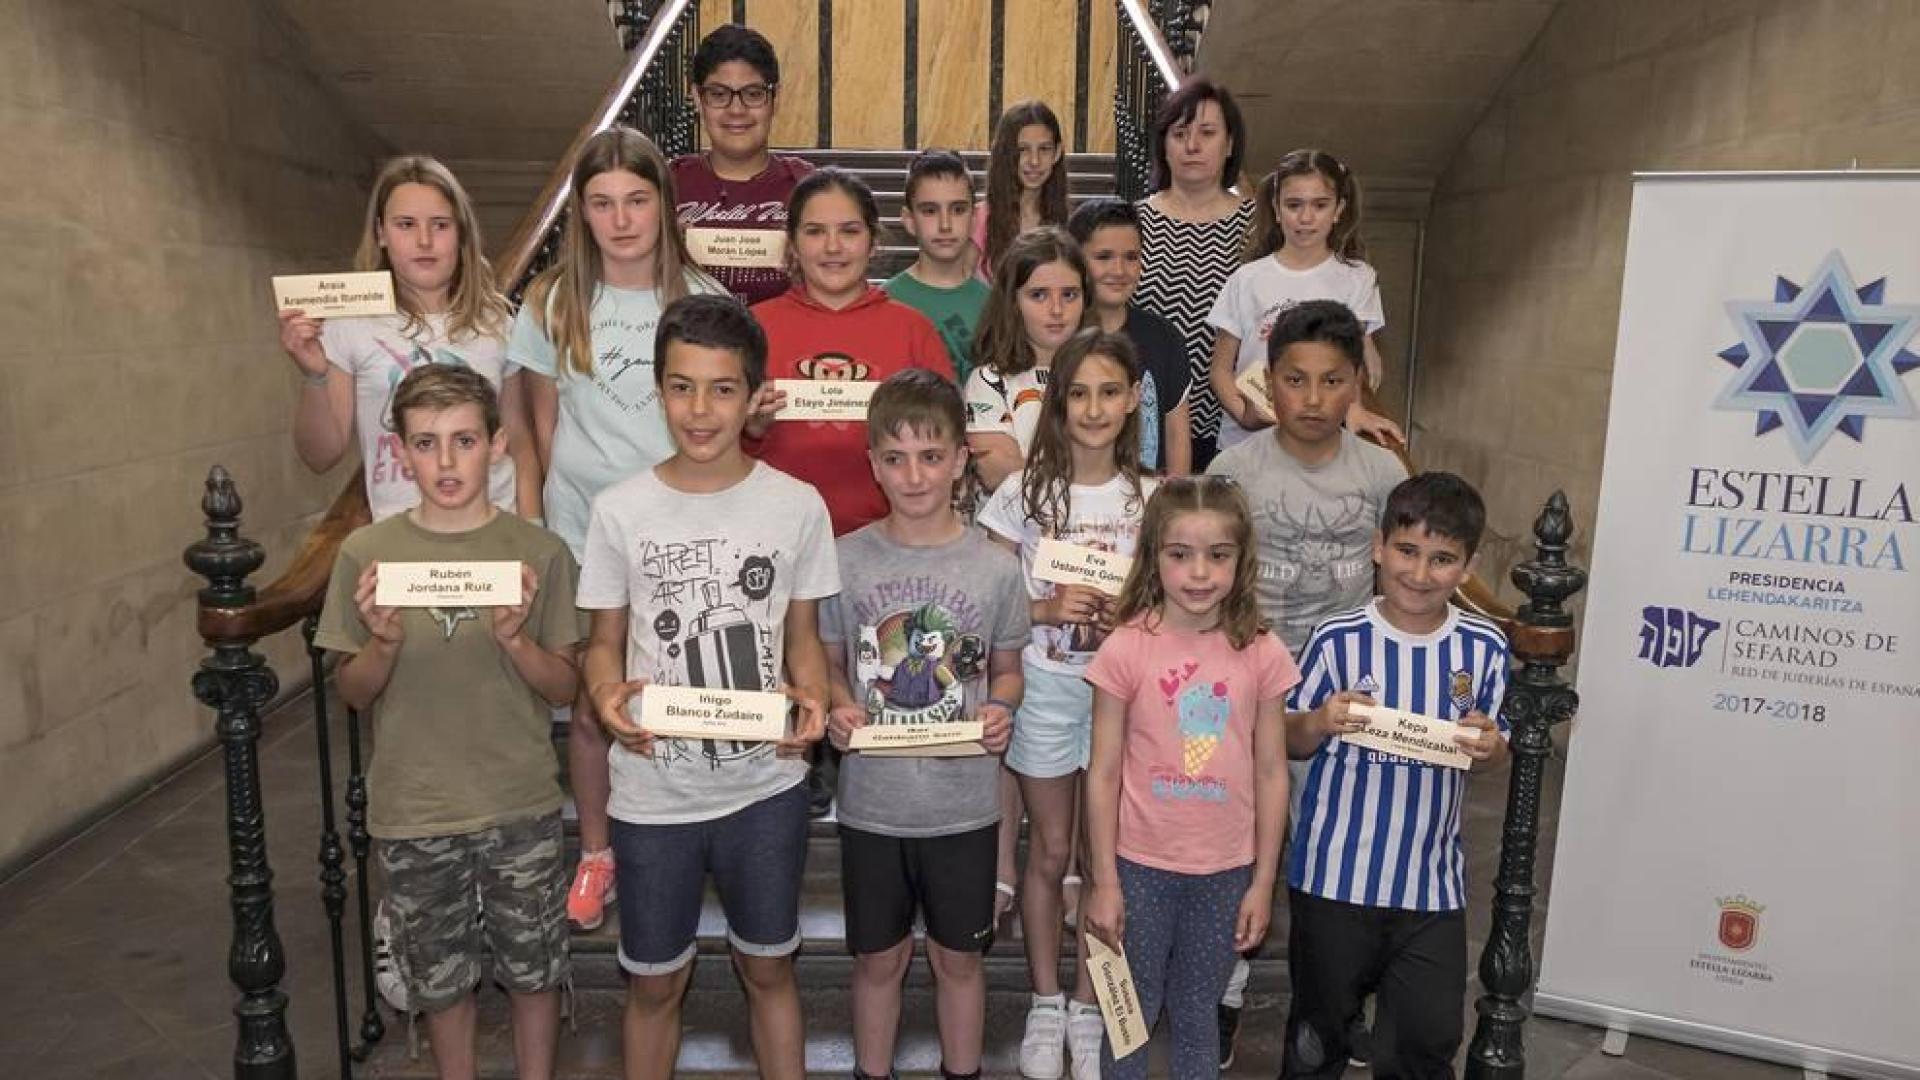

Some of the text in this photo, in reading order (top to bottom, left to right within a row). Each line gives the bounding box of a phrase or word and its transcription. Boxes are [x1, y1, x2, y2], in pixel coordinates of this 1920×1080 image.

[821, 386, 844, 395] Lola
[1687, 468, 1919, 524] ESTELLA
[1679, 514, 1907, 572] LIZARRA
[1086, 554, 1106, 566] Eva
[430, 569, 472, 579] Rubén
[1729, 571, 1846, 594] PRESIDENCIA
[407, 583, 493, 593] Jordana Ruiz
[1707, 587, 1863, 613] LEHENDAKARITZA
[1735, 619, 1899, 653] CAMINOS DE
[1733, 641, 1838, 668] SEFARAD
[1732, 666, 1758, 678] RED
[1762, 669, 1778, 680] DE
[1850, 680, 1866, 691] DE
[666, 705, 763, 722] Blanco Zudaire
[1713, 693, 1826, 723] 2017-2018
[1398, 718, 1429, 733] Kepa
